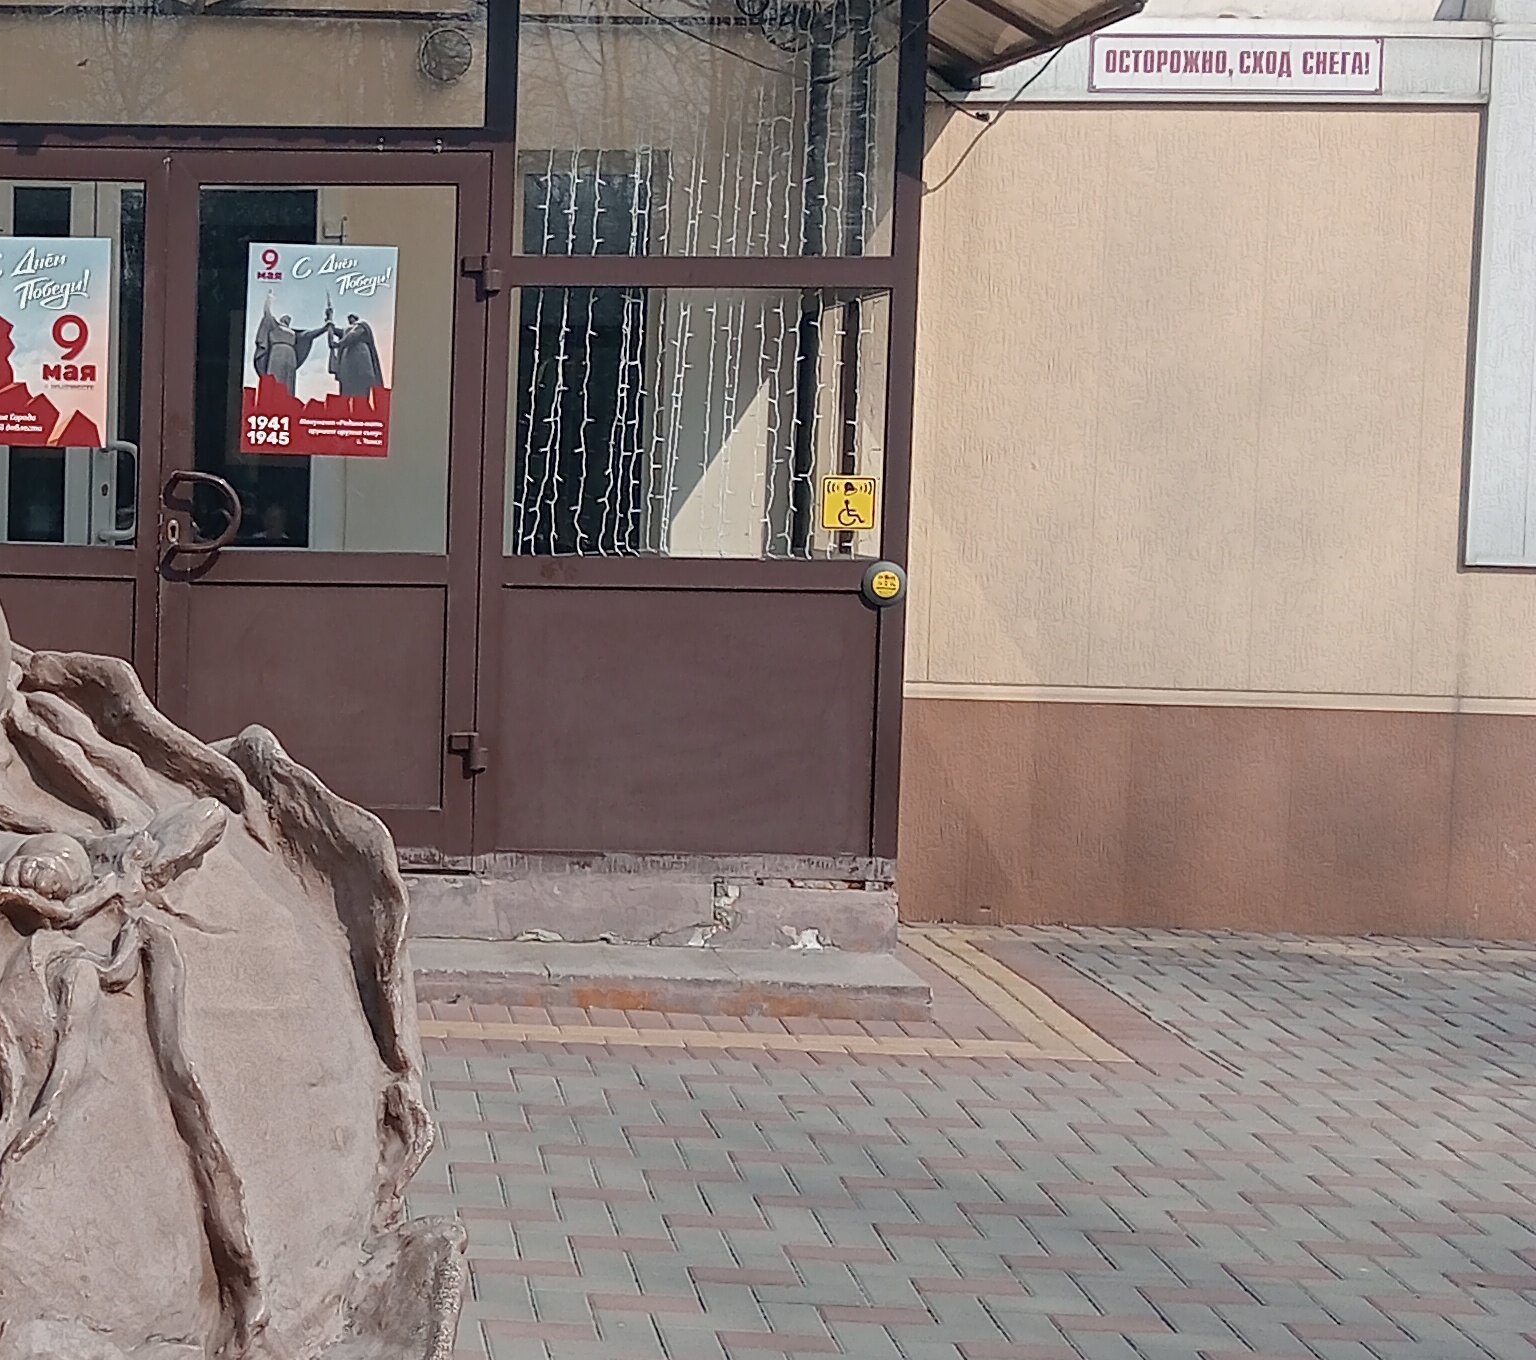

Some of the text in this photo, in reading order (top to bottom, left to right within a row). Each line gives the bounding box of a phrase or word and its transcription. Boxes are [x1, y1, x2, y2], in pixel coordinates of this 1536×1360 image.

[1105, 49, 1371, 78] ОСТОРОЖНО, СХОД СНЕГА!
[10, 246, 68, 277] Днём
[261, 249, 279, 271] 9
[291, 256, 313, 279] С
[256, 271, 283, 281] мая
[51, 314, 89, 361] 9
[42, 363, 97, 382] мая
[247, 415, 290, 431] 1941
[246, 430, 290, 446] 1945
